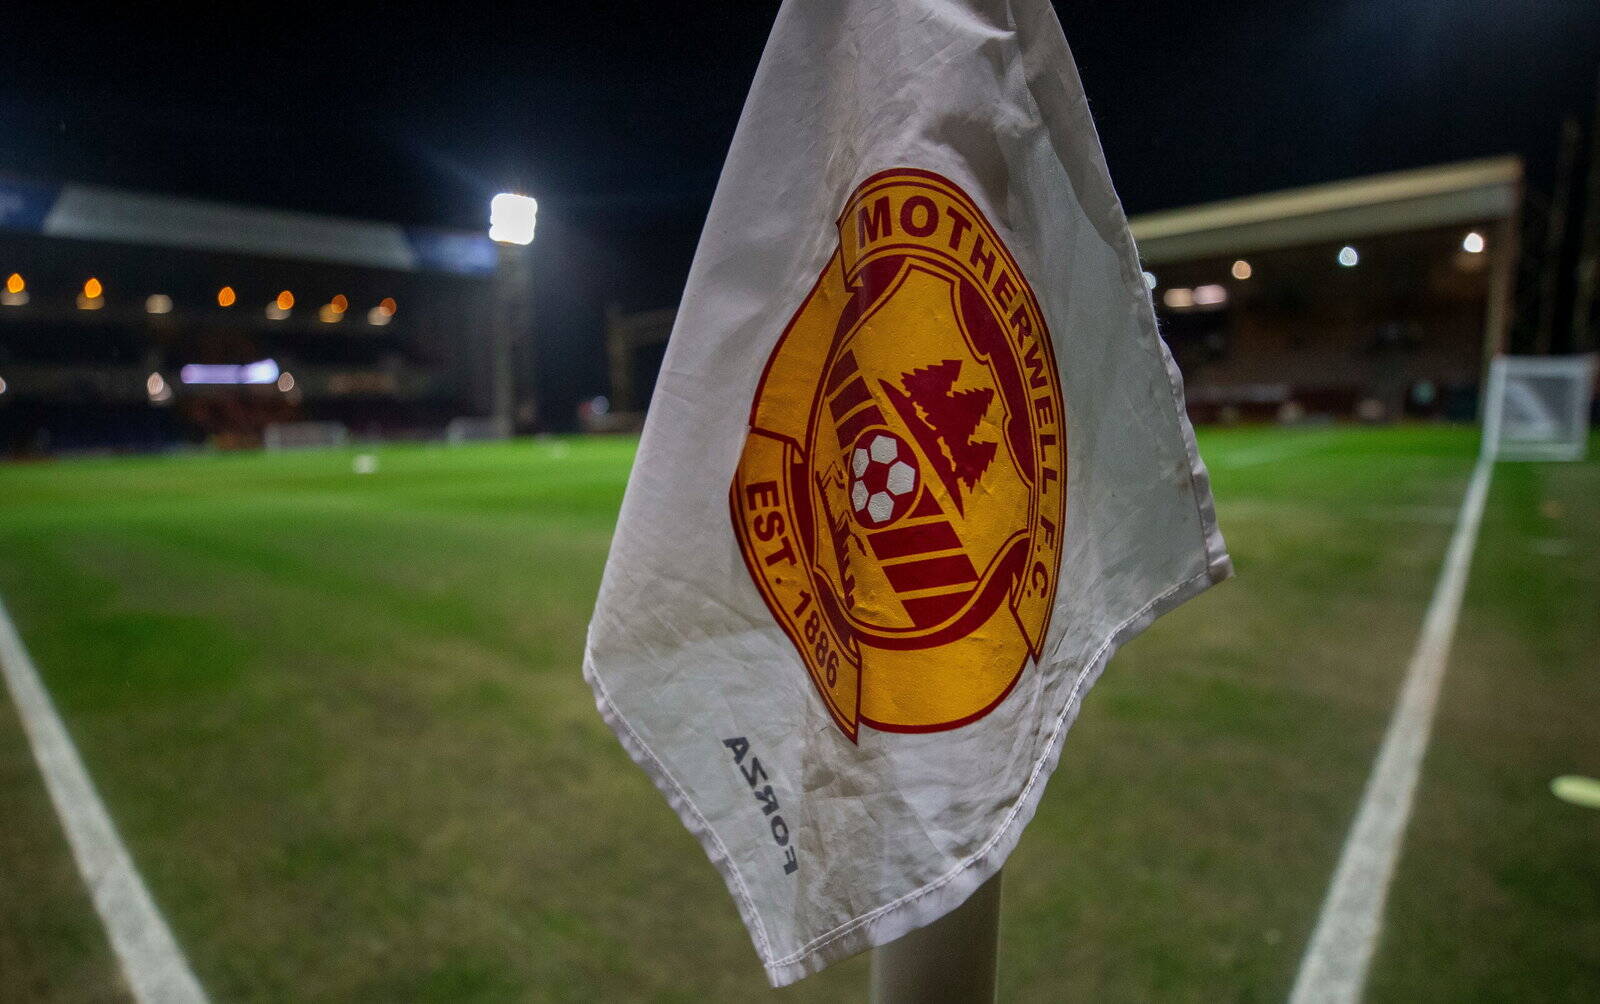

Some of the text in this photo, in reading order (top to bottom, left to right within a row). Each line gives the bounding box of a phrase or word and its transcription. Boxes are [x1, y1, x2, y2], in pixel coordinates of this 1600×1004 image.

[857, 195, 1058, 599] MOTHERWELL F.C.
[746, 480, 839, 689] EST. 1886
